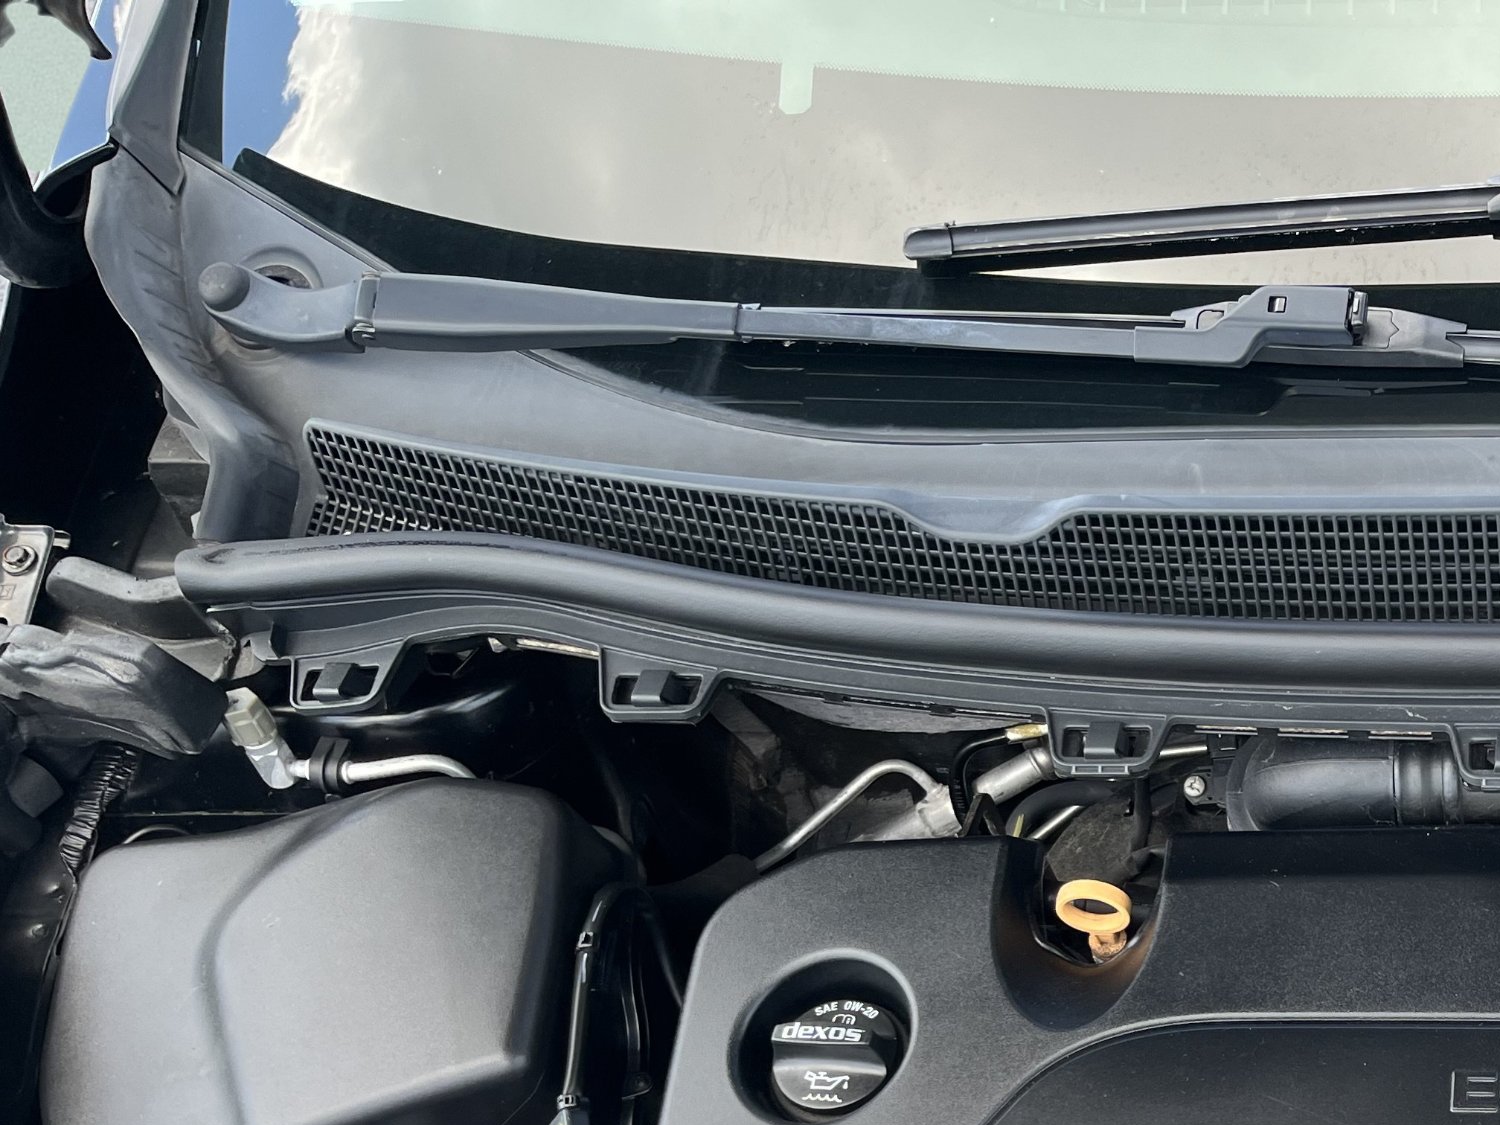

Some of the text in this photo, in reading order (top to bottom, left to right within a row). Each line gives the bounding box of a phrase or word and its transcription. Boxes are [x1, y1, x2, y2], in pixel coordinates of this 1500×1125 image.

[814, 1000, 879, 1019] SAE 0W-20
[781, 1022, 863, 1042] dexos
